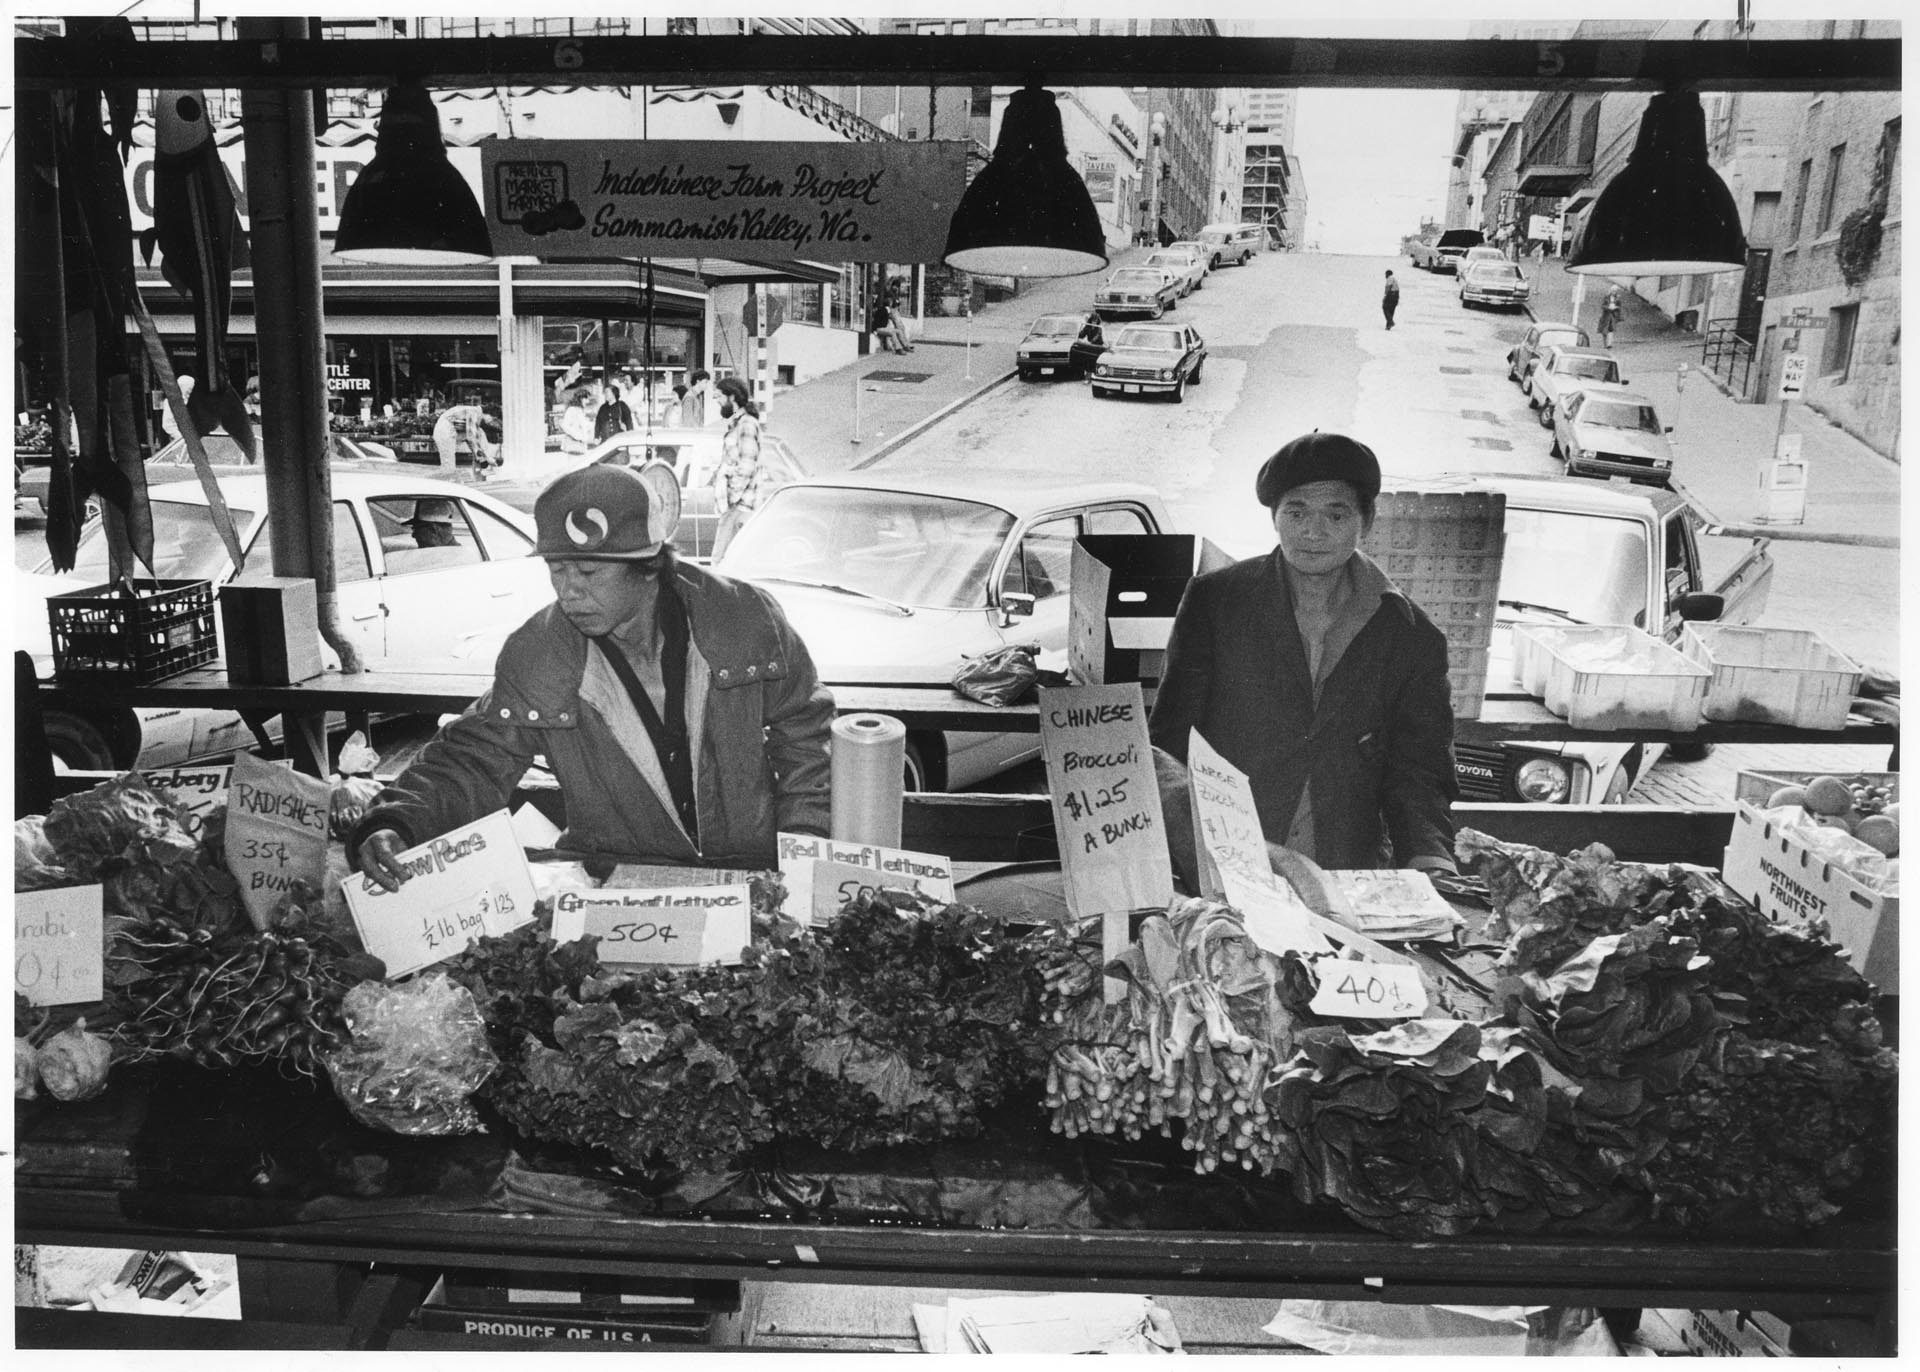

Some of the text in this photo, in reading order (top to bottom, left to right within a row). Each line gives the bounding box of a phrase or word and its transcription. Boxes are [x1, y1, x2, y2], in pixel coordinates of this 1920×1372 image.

[554, 38, 583, 69] 6
[1087, 161, 1115, 169] TAVERN
[595, 160, 886, 206] Indochinese Farm Project
[1785, 372, 1803, 381] WAY
[1786, 359, 1805, 370] ONE
[327, 378, 371, 390] CENTER
[1051, 704, 1133, 728] CHINESE
[1063, 744, 1138, 773] Broccoli
[235, 783, 326, 830] RADISHES
[1064, 778, 1129, 821] $1.25
[1084, 811, 1153, 854] A BUNCH
[243, 840, 290, 868] 35¢
[780, 838, 819, 860] Red
[1760, 857, 1828, 915] NORTHWEST
[1770, 882, 1807, 919] FRUITS
[608, 923, 678, 943] 50¢
[465, 1321, 556, 1338] PRODUCE
[567, 1328, 593, 1340] OF
